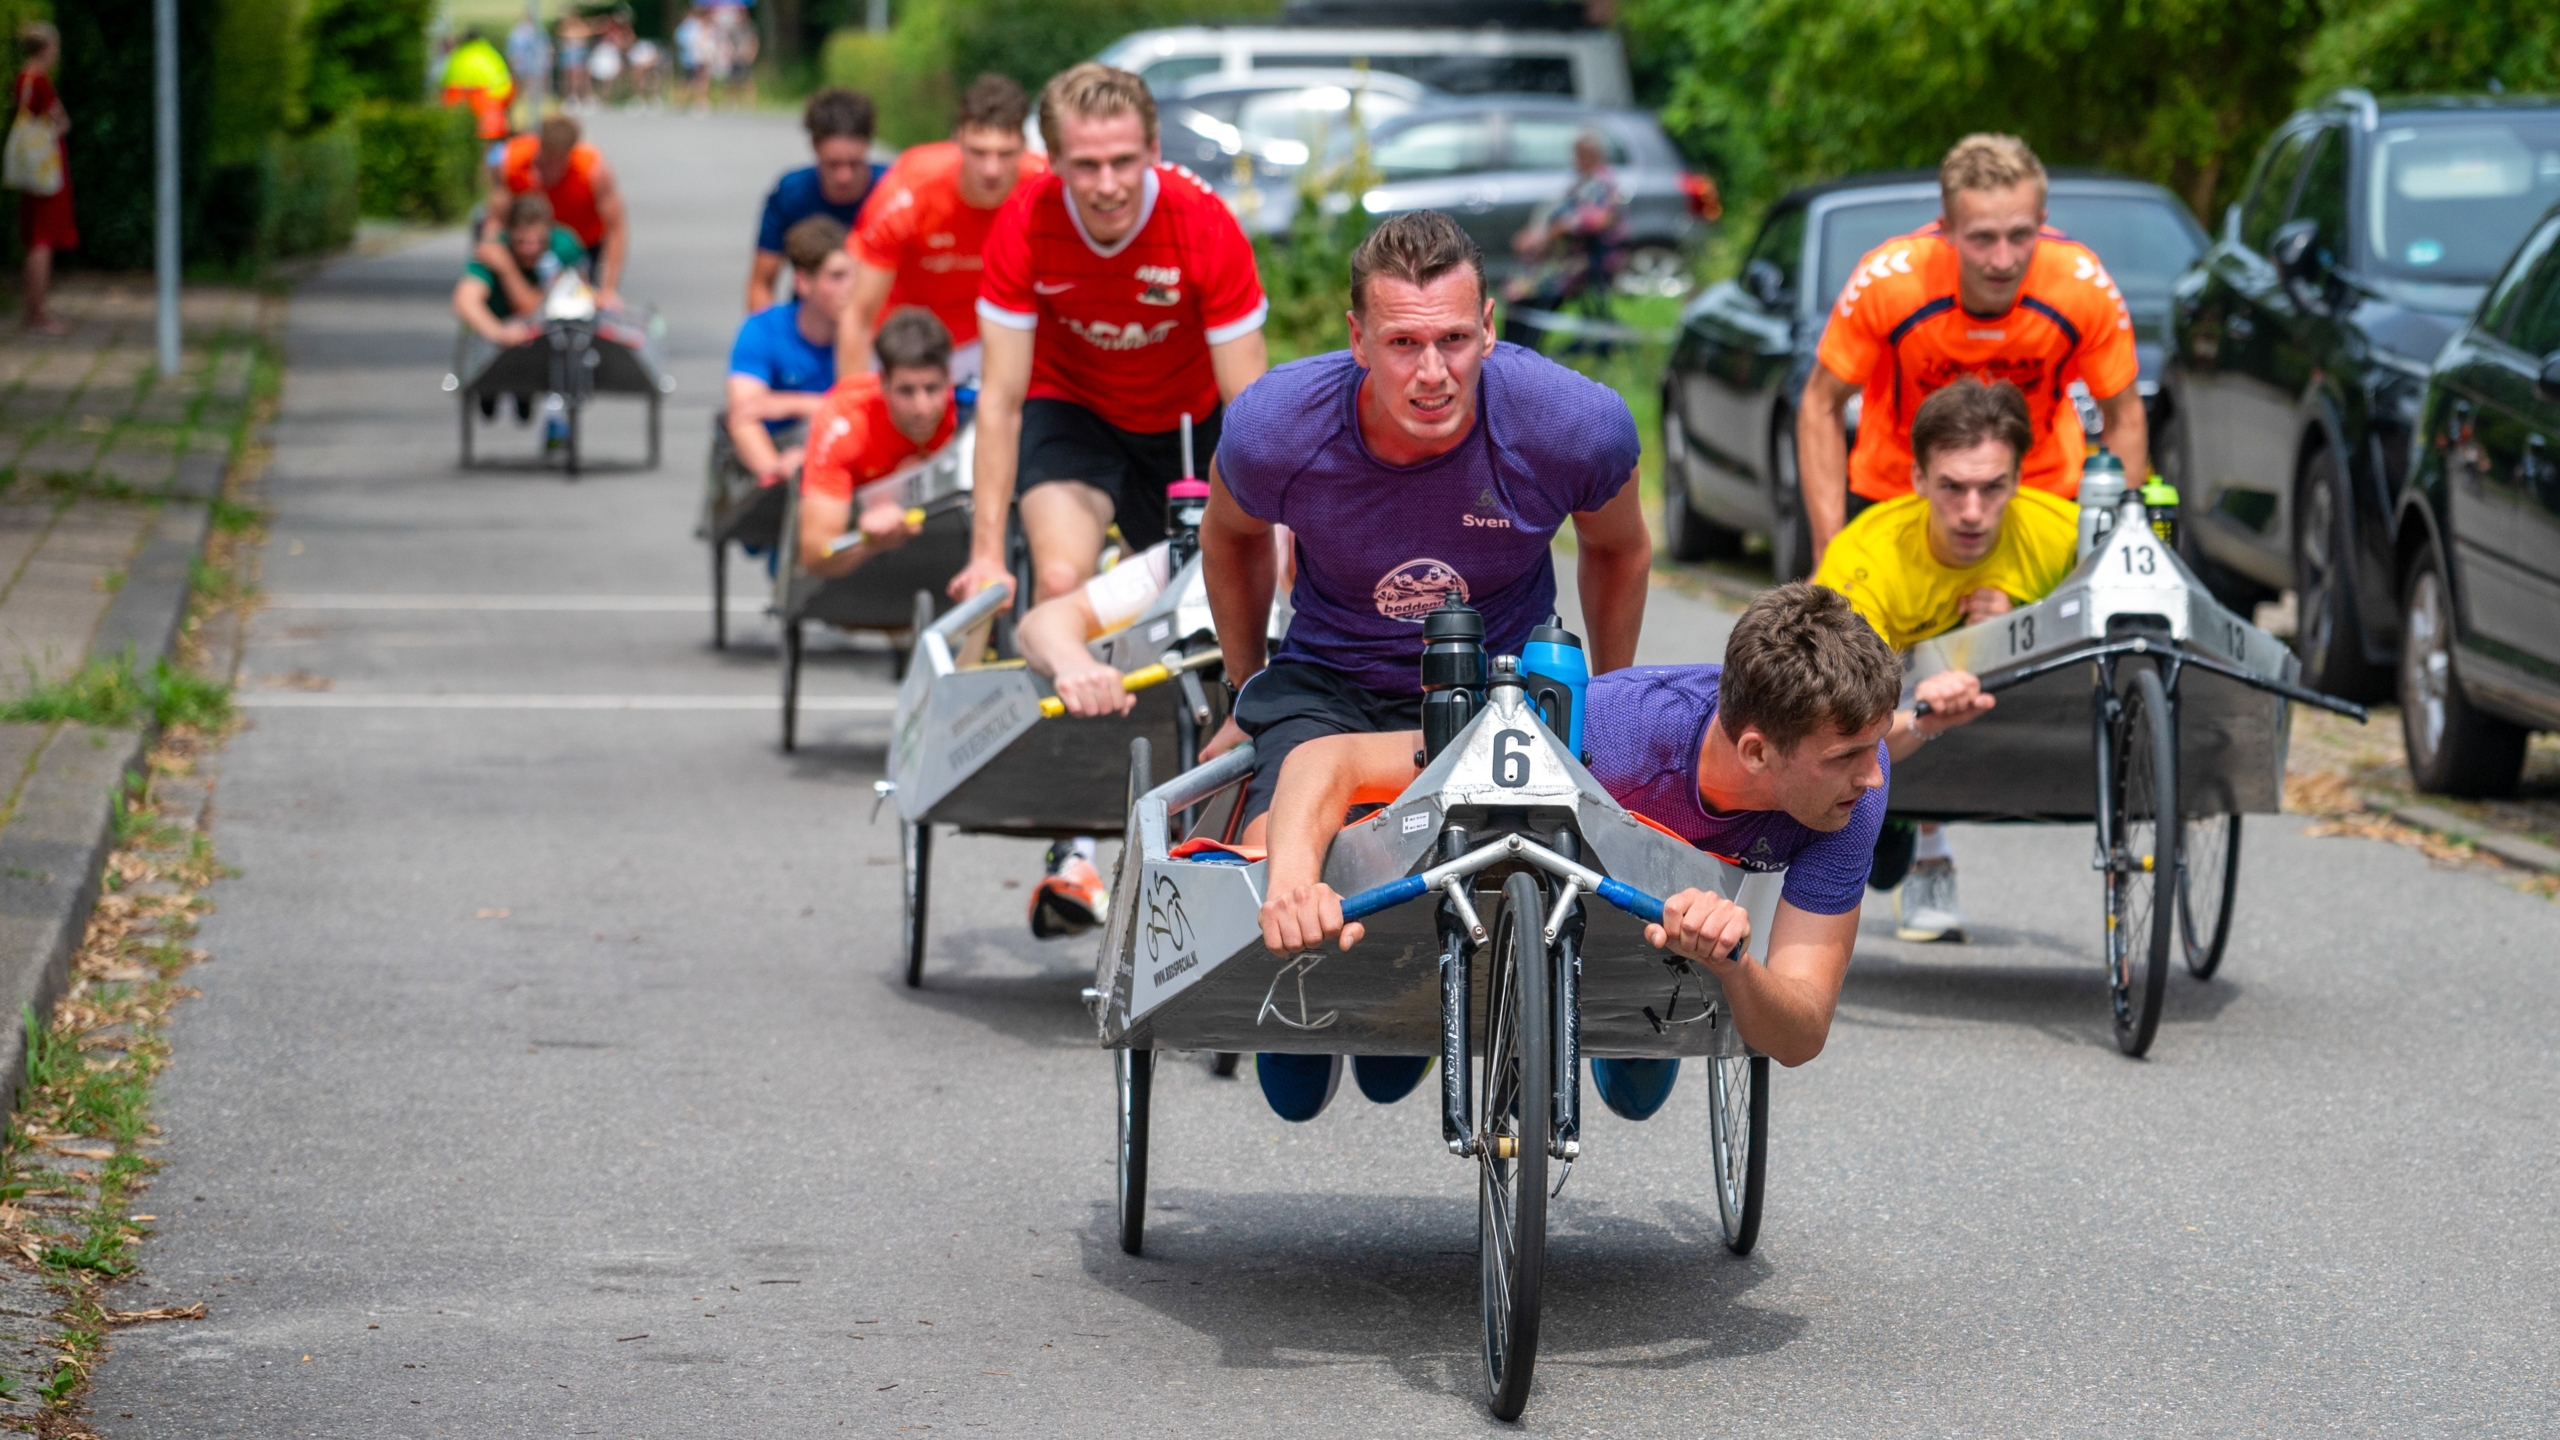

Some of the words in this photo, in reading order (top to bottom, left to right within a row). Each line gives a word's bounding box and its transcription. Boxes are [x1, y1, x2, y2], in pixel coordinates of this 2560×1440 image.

[1462, 513, 1511, 528] Sven
[2121, 545, 2156, 576] 13
[1383, 599, 1446, 615] beddenr
[2008, 614, 2035, 656] 13
[2225, 620, 2246, 662] 13
[1492, 728, 1531, 788] 6
